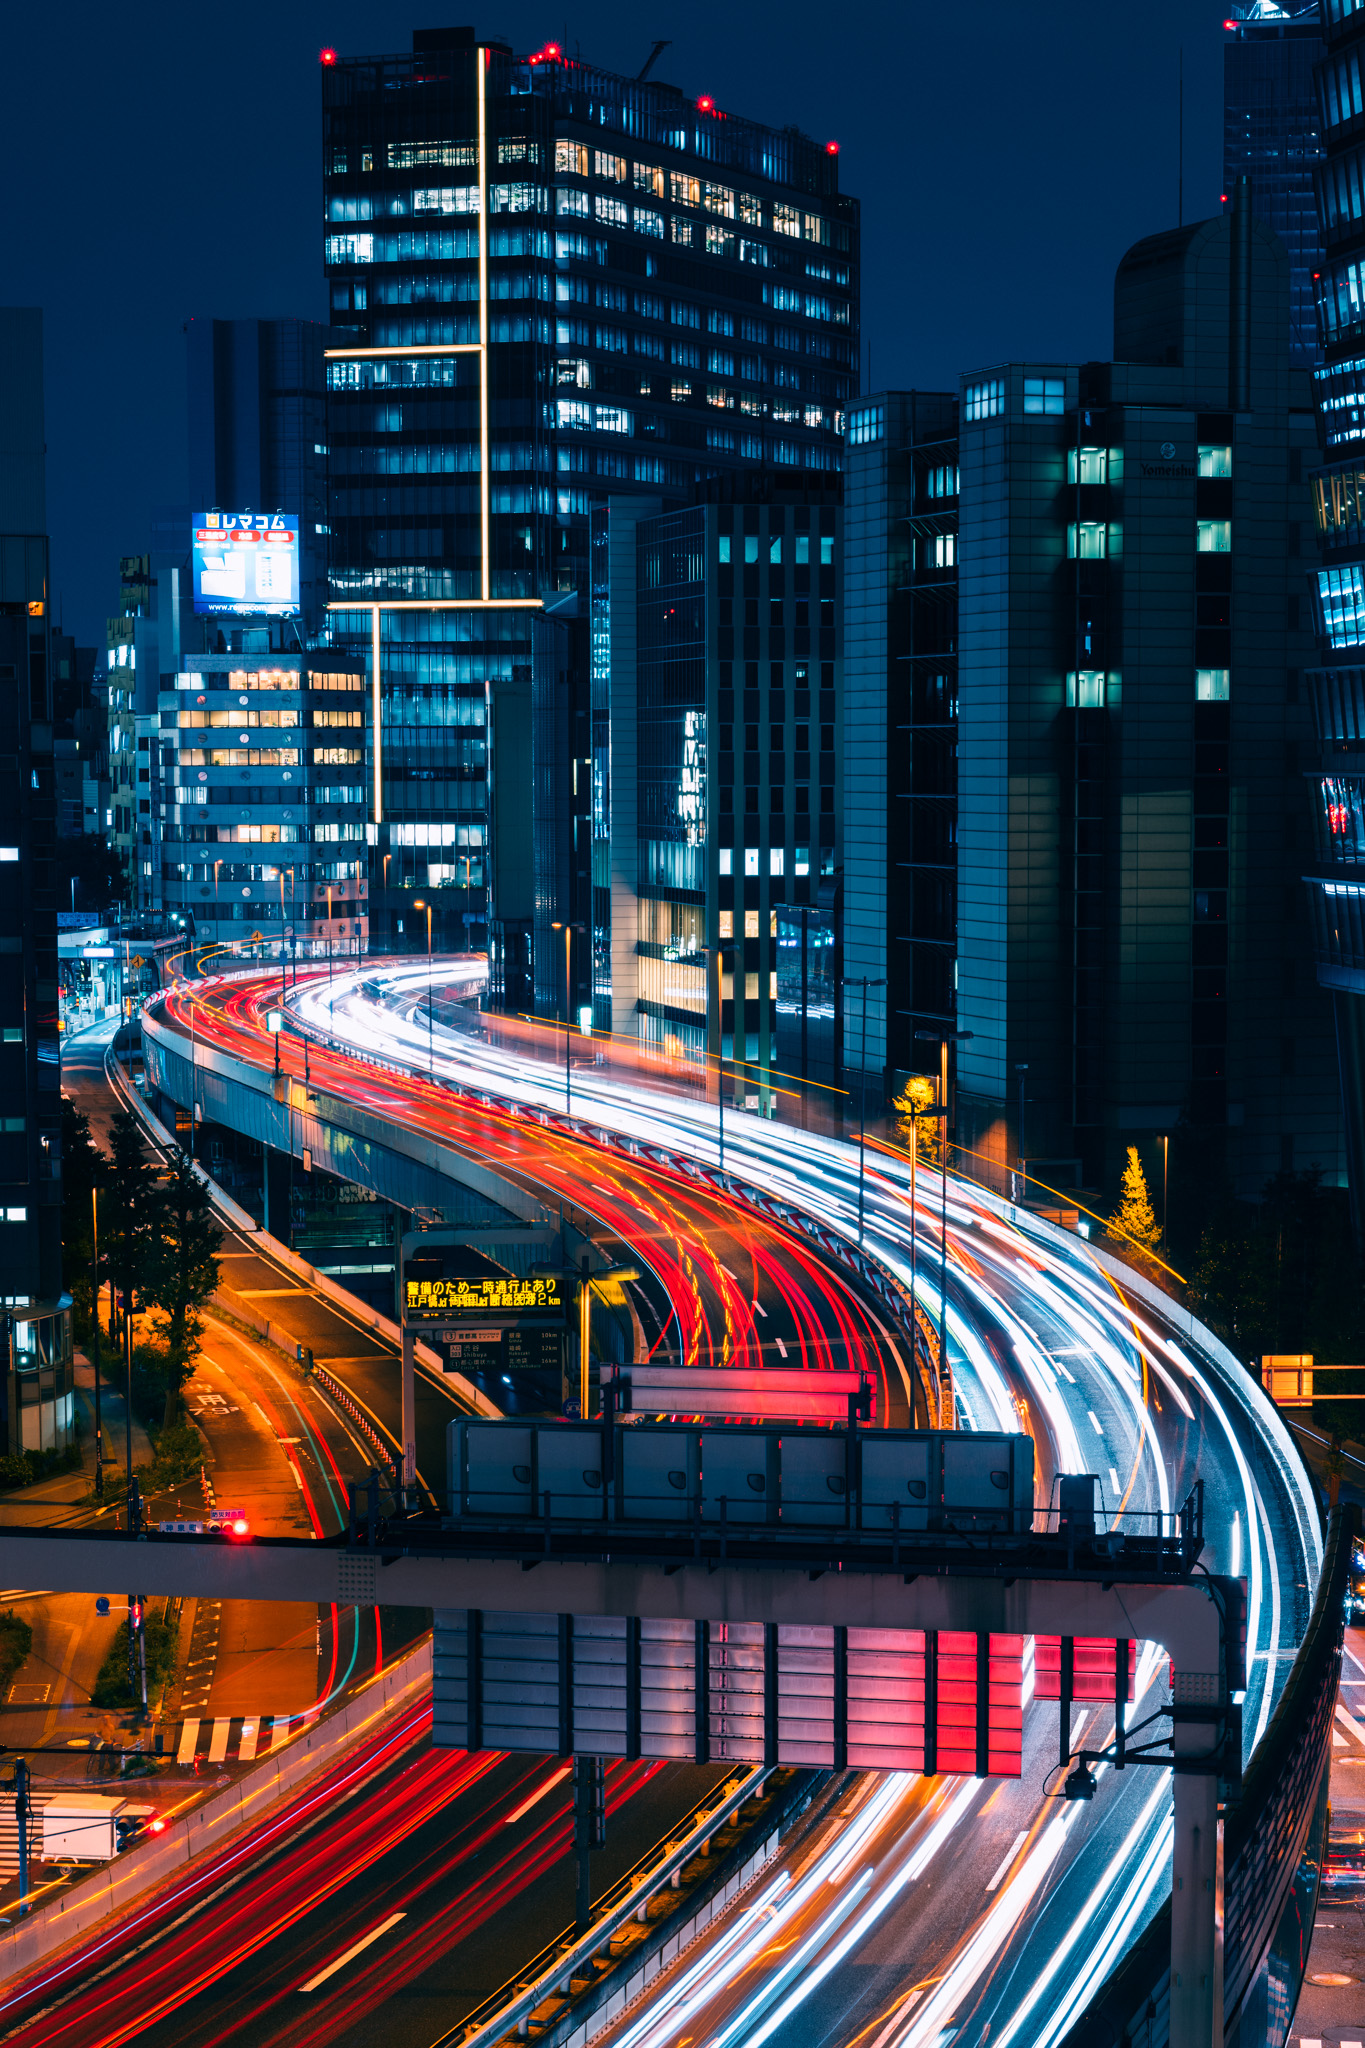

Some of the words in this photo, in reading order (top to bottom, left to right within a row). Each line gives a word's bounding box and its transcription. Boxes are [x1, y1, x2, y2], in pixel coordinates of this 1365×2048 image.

[1141, 463, 1195, 476] Yomeishu
[222, 514, 285, 529] レマコム
[165, 1524, 197, 1532] 神泉町
